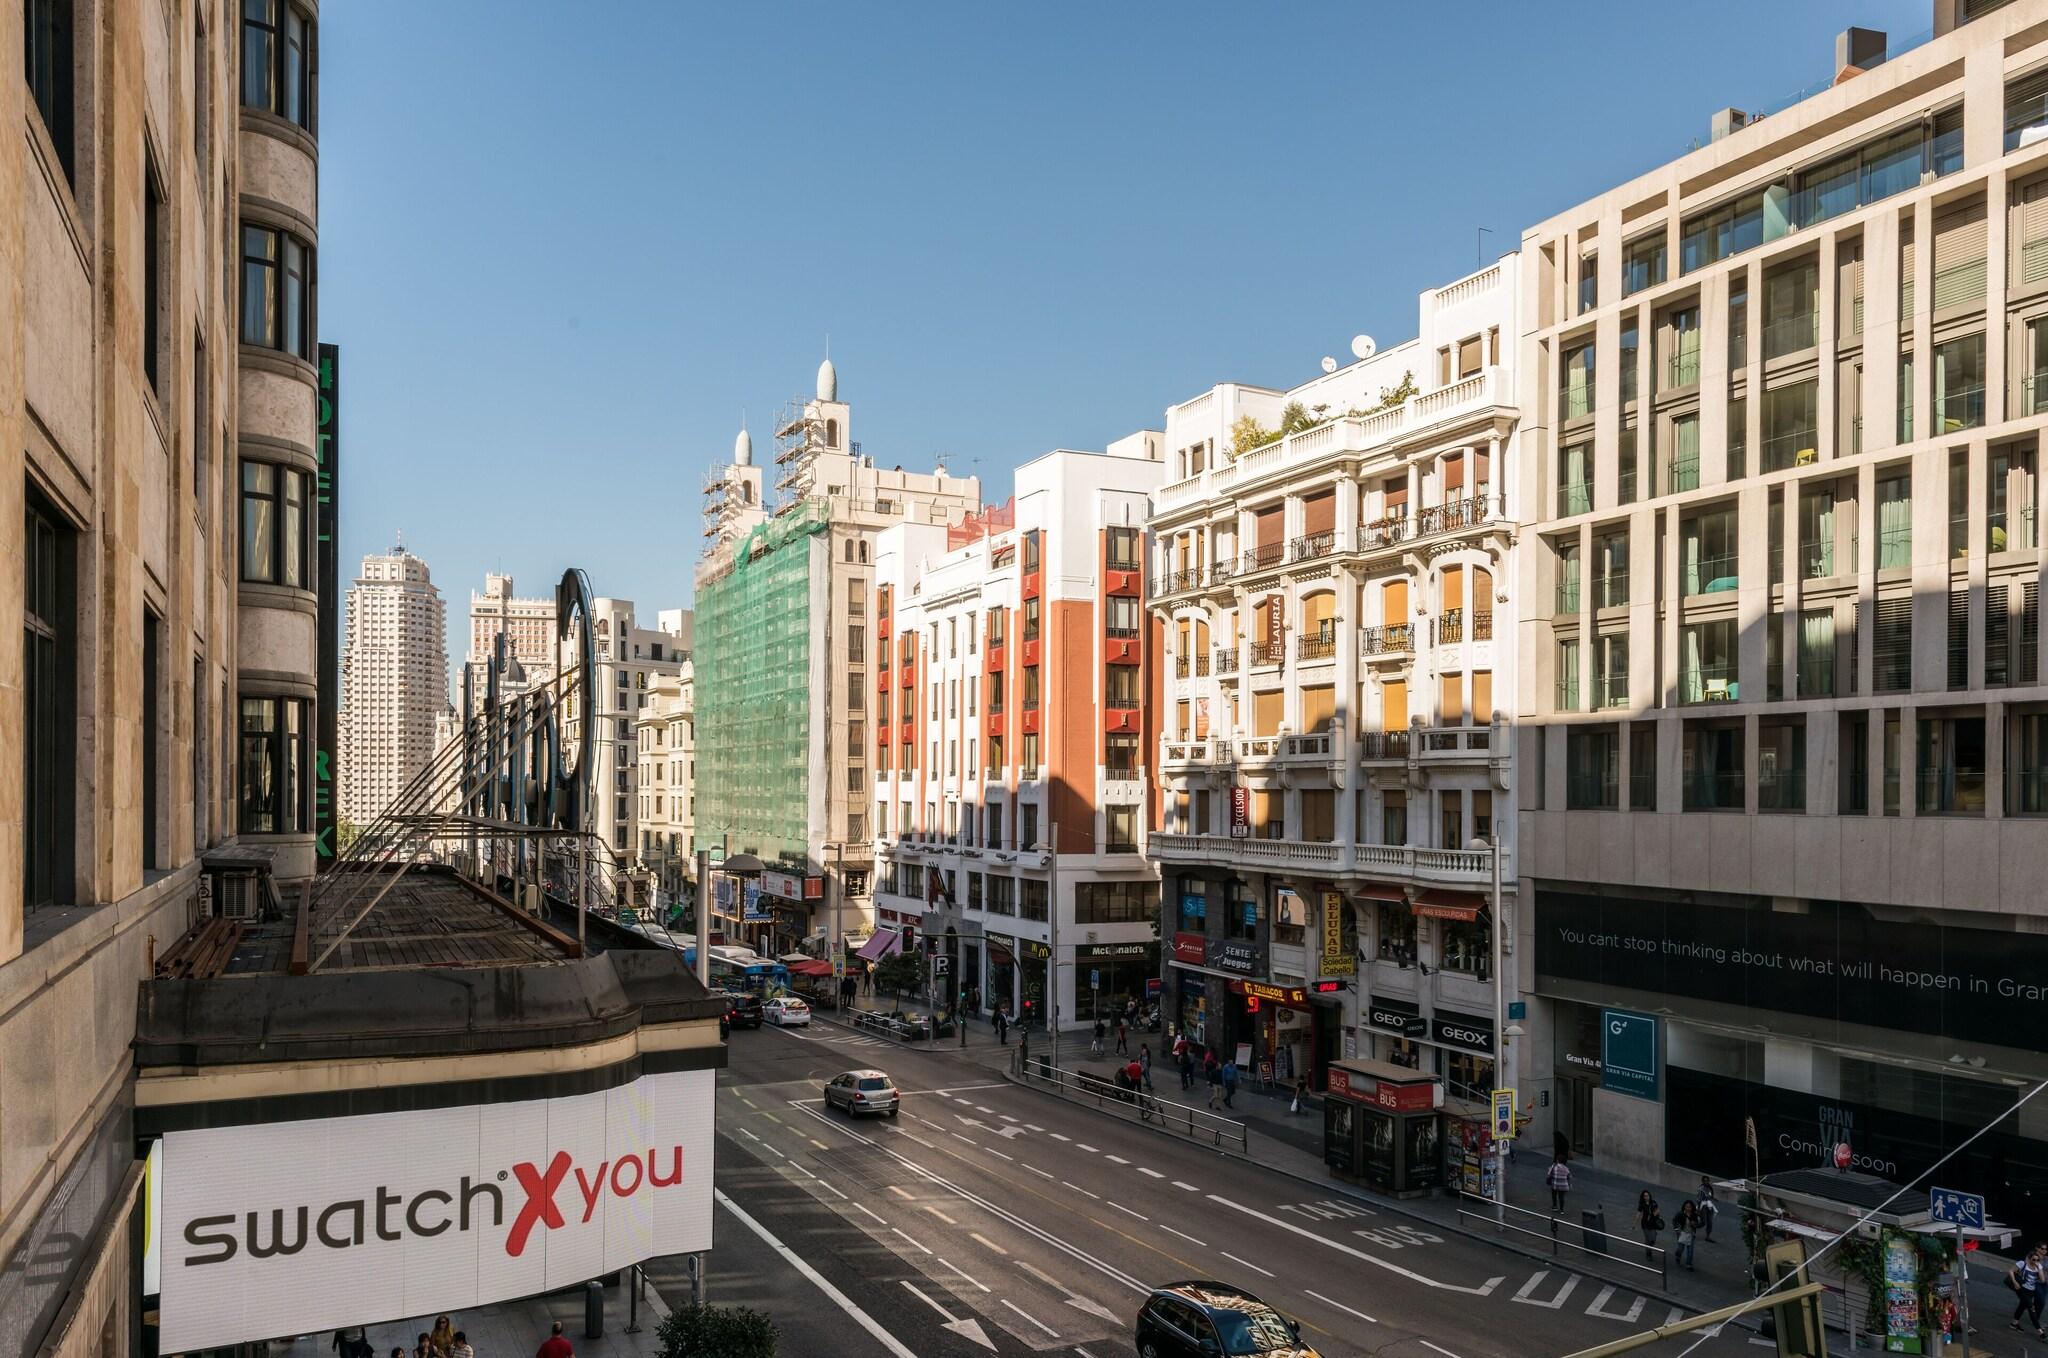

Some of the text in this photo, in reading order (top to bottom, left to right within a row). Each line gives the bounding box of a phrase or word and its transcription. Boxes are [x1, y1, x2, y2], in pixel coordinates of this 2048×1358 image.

[1235, 788, 1244, 826] EXCELSIOR
[1327, 894, 1338, 955] PELUCAS
[1092, 945, 1144, 956] McDnald's
[1222, 957, 1252, 970] Juegos
[1323, 958, 1352, 966] Soledad
[1559, 928, 1584, 944] You
[1588, 933, 1619, 948] cant
[1623, 936, 1657, 953] stop
[1661, 939, 1726, 964] thinking
[1731, 948, 1783, 969] about
[1789, 956, 1833, 975] what
[1840, 961, 1872, 979] will
[1880, 964, 1960, 990] happen
[1969, 974, 1988, 994] in
[1323, 966, 1351, 975] Cabello
[1254, 984, 1283, 998] TABACOS
[1373, 1011, 1406, 1027] GEO
[1441, 1026, 1488, 1046] GEOX
[1566, 1053, 1582, 1064] Gran
[1330, 1074, 1346, 1087] BUS
[1605, 1067, 1620, 1075] GRAN
[1631, 1072, 1654, 1083] CAPITAL
[1379, 1093, 1397, 1108] BUS
[1818, 1105, 1854, 1128] GRAN
[1778, 1133, 1897, 1176] Comin soon
[1276, 1199, 1377, 1221] TAXI
[1351, 1225, 1445, 1249] BUS
